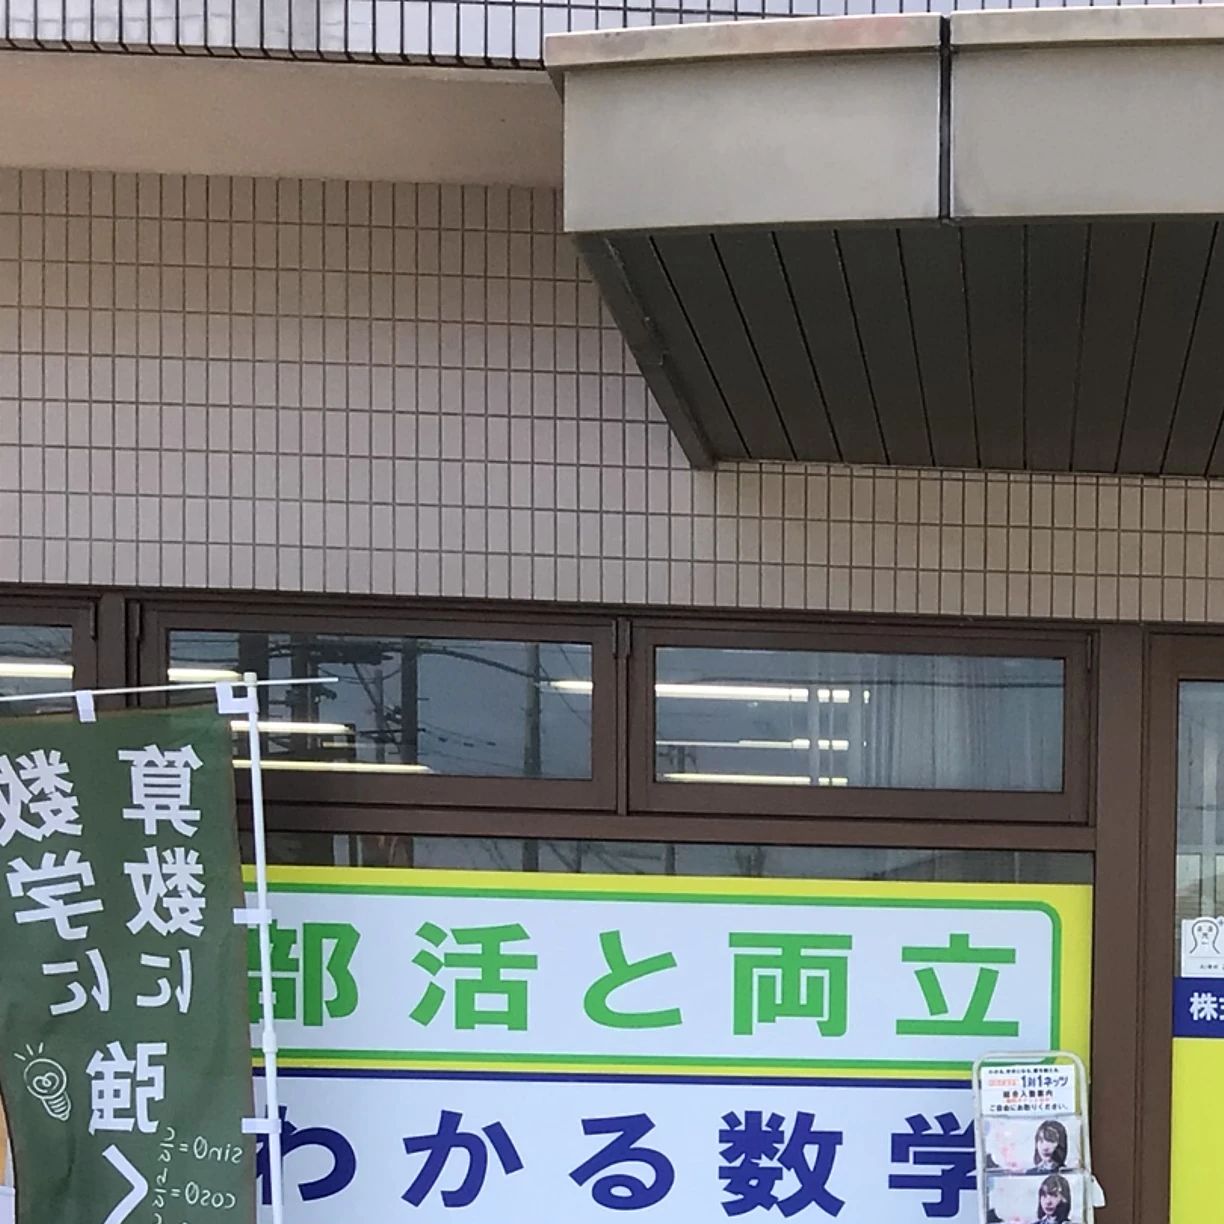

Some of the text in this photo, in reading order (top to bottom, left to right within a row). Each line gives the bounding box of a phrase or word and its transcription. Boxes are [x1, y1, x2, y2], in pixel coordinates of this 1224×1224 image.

[247, 919, 1019, 1037] 部活と両立
[256, 1104, 977, 1218] わかる数学
